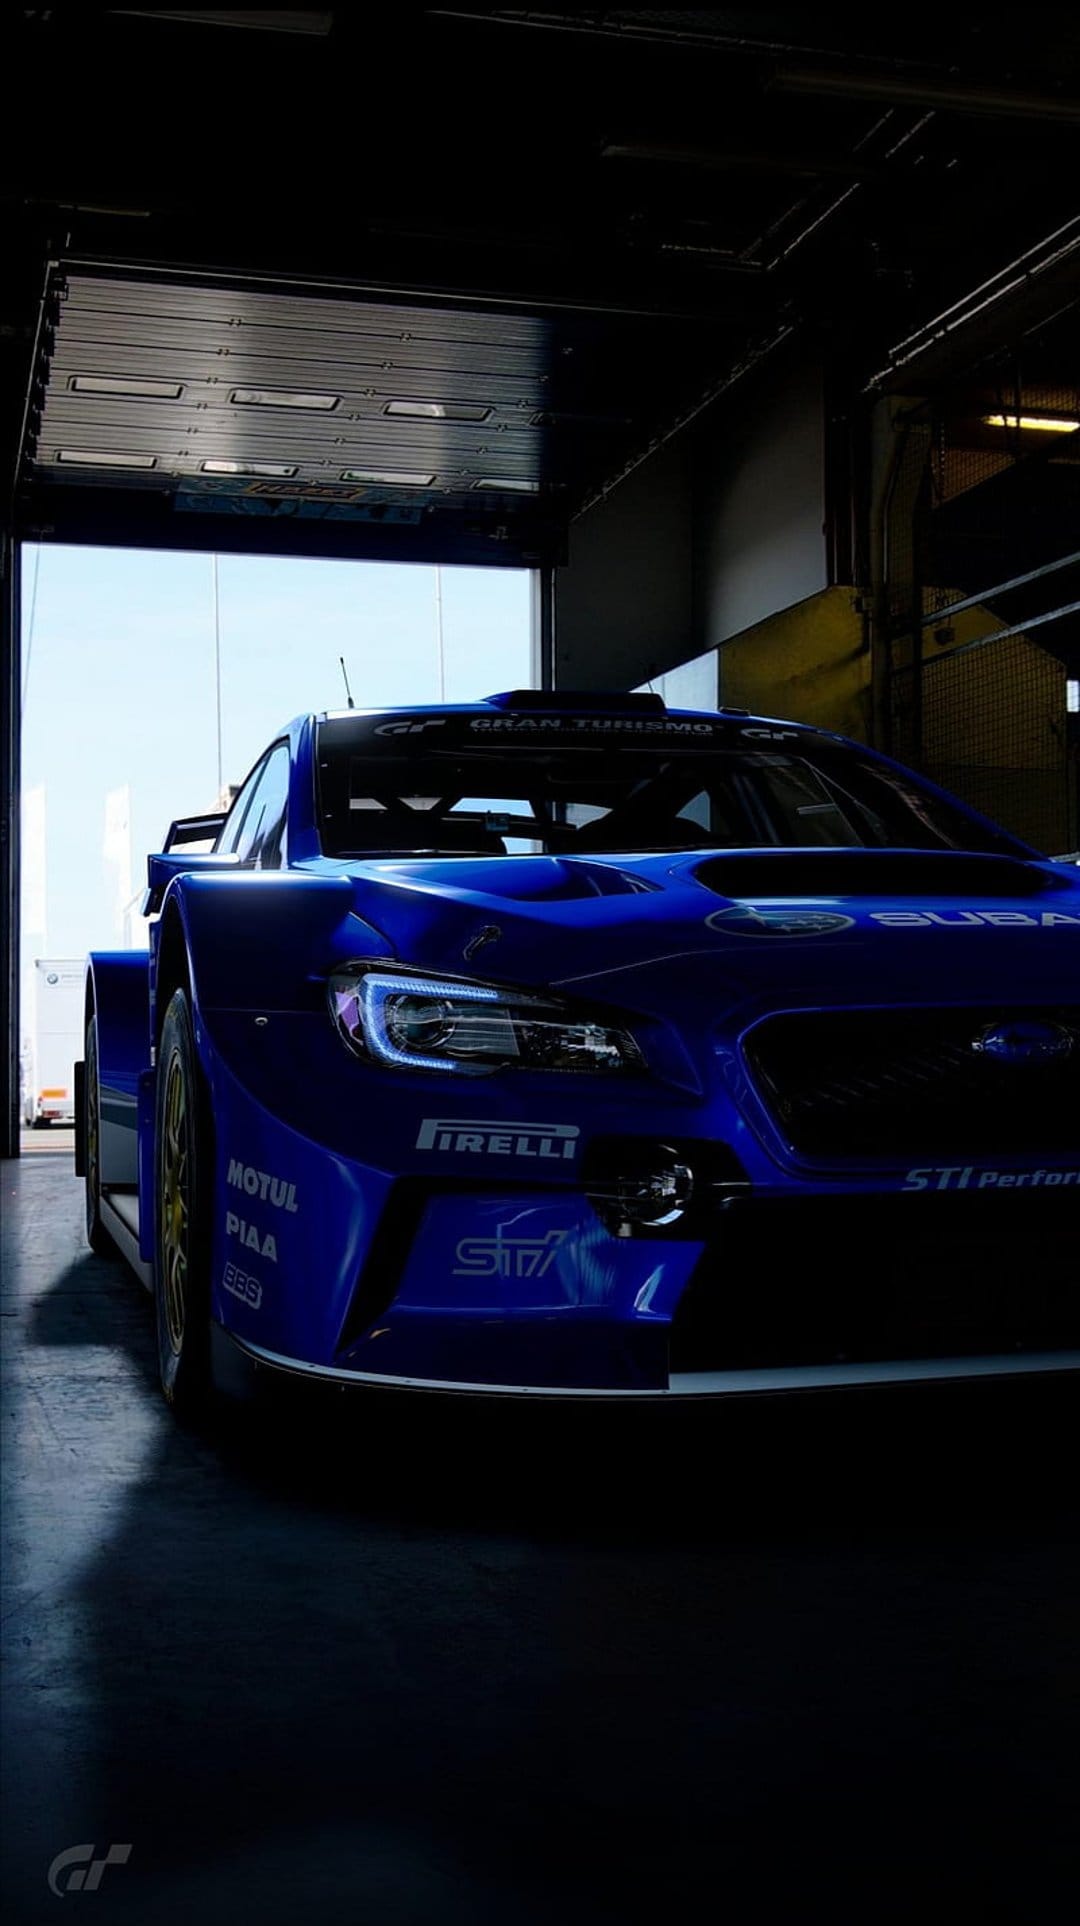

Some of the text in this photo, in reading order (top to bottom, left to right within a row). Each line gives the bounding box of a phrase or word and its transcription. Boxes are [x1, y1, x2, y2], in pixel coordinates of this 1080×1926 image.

[469, 718, 713, 732] GRAN TURISMO
[869, 911, 1080, 927] SUBA
[415, 1118, 581, 1159] PIRELLI
[226, 1157, 299, 1214] MOTUL
[901, 1166, 1080, 1192] STI Perfor
[225, 1210, 278, 1264] PIAA
[222, 1260, 263, 1310] BBS
